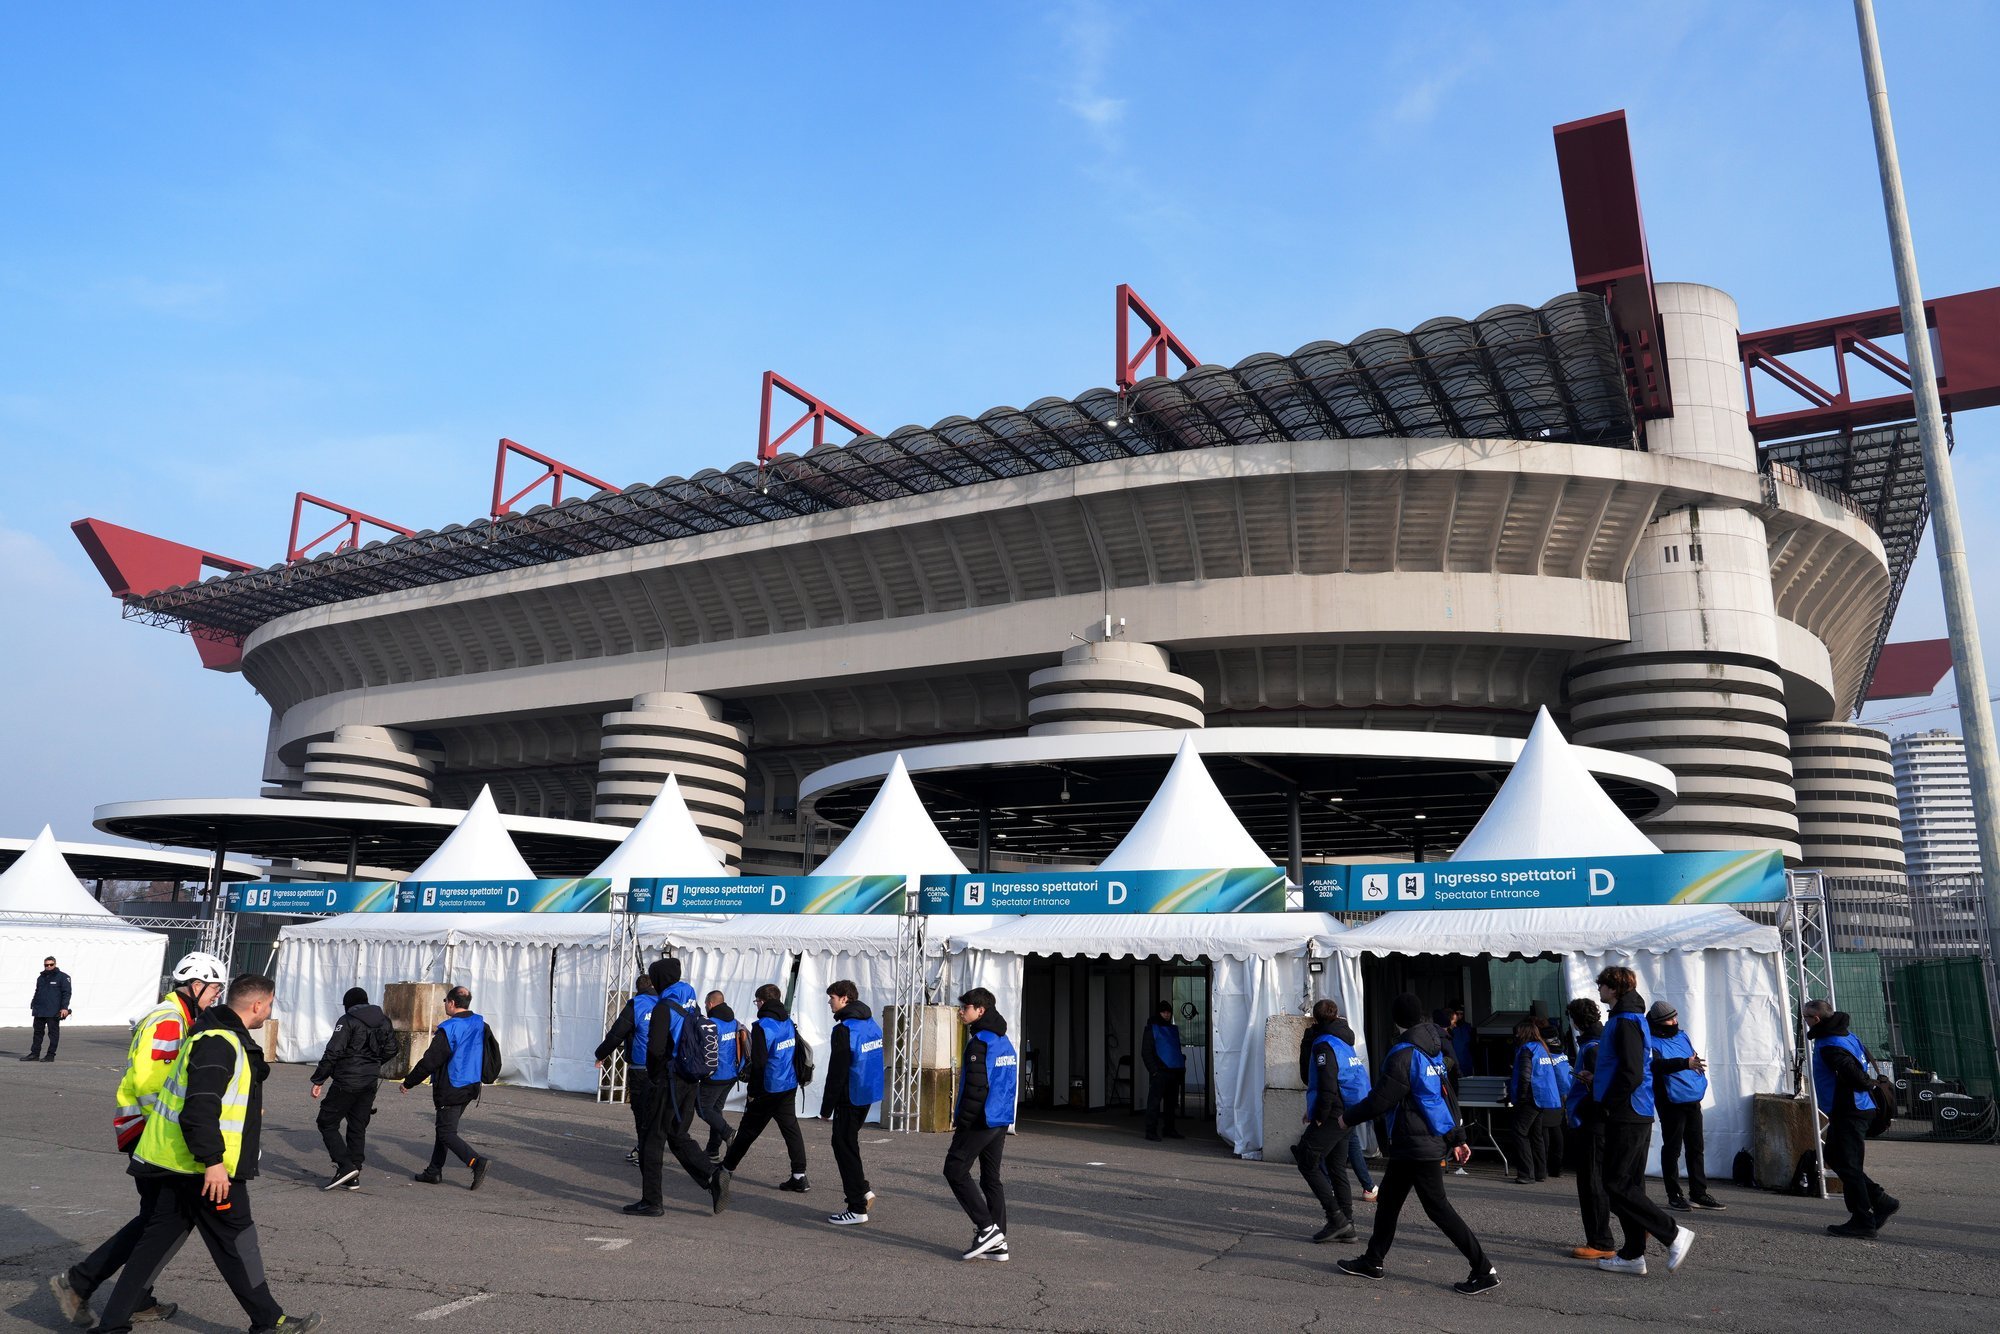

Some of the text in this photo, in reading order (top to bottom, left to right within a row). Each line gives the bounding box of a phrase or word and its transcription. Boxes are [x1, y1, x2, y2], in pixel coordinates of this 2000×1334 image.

[1435, 868, 1575, 887] Ingresso spettatori
[1589, 869, 1614, 895] D
[273, 889, 324, 898] Ingresso spettatori
[440, 887, 503, 898] Ingresso spettatori
[684, 884, 764, 896] Ingresso spettatori
[771, 885, 785, 905] D
[992, 880, 1098, 895] Ingresso spettatori
[1108, 882, 1127, 904] D
[326, 890, 336, 906] D
[507, 888, 519, 905] D
[683, 899, 713, 907] Spectator
[992, 898, 1031, 907] Spectator
[1435, 890, 1539, 901] Spectator Entrance
